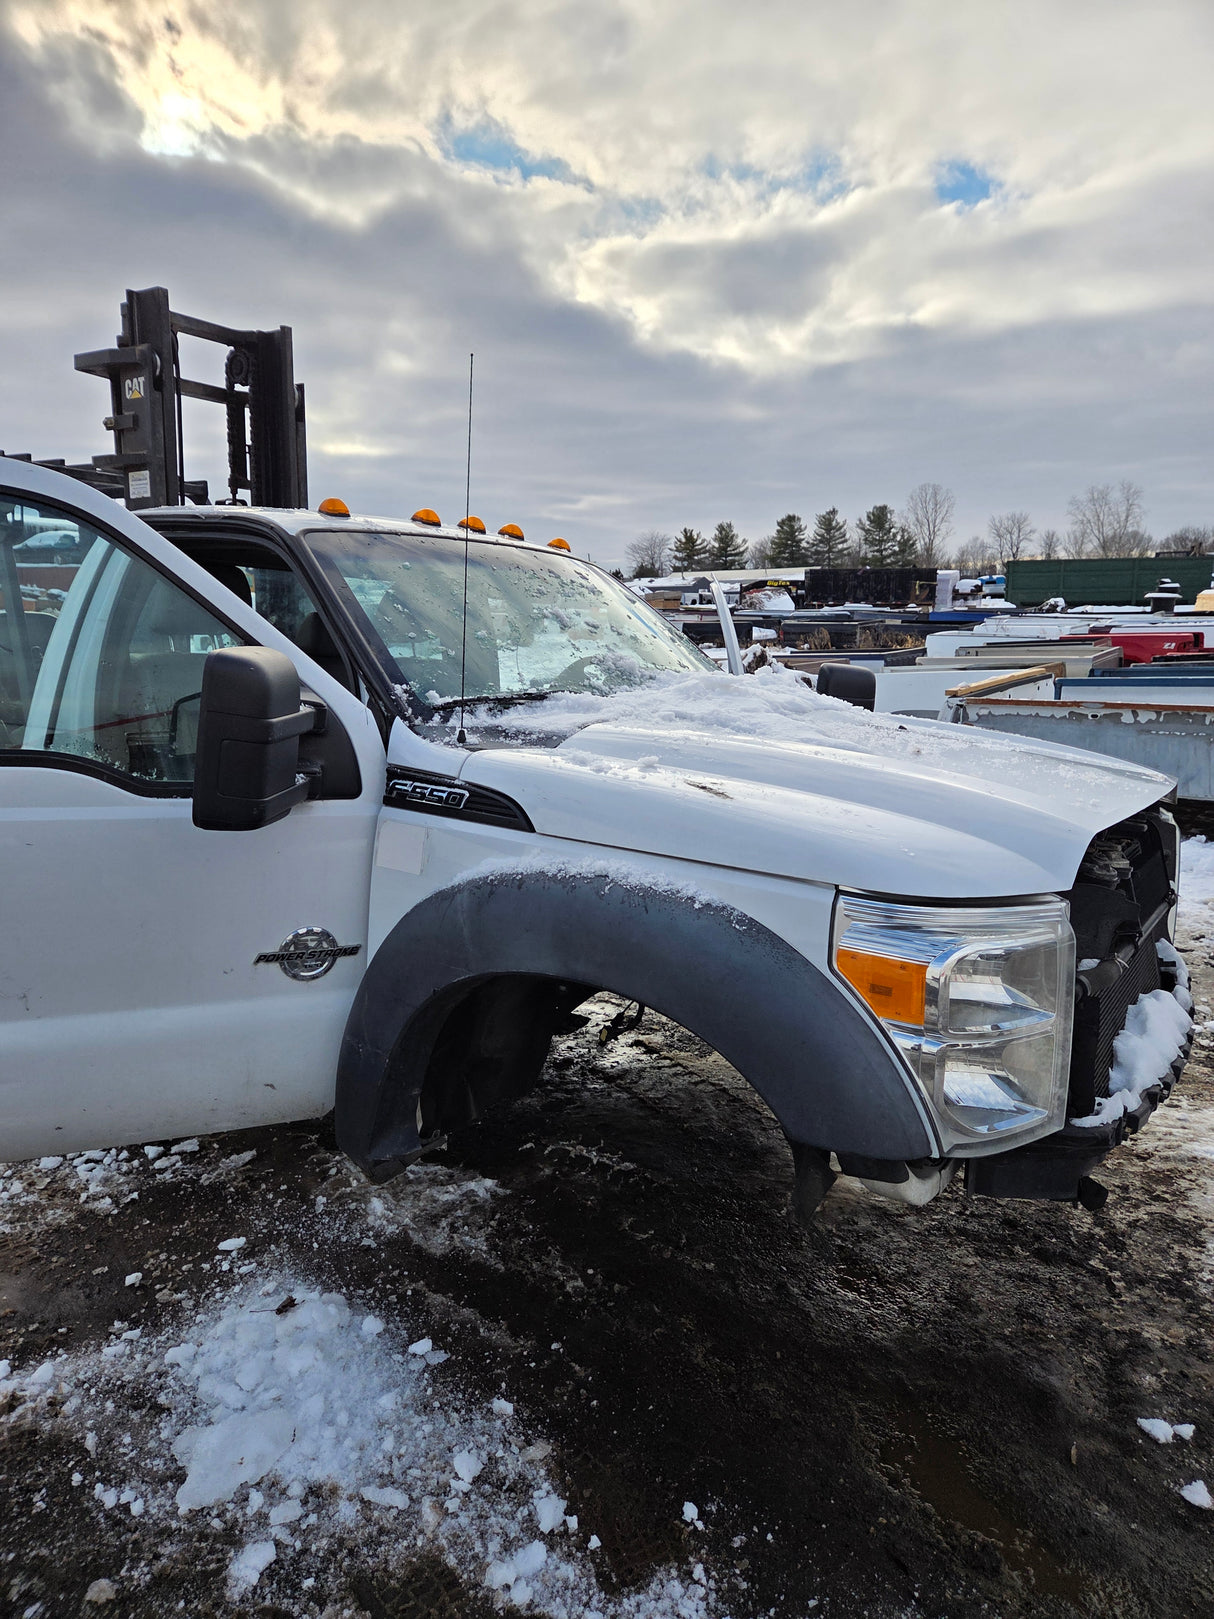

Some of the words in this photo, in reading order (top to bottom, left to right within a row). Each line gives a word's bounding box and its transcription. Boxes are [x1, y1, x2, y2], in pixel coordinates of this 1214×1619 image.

[125, 376, 145, 399] CAT
[388, 779, 470, 809] F550
[255, 951, 306, 963] POWER
[306, 946, 360, 959] STROKE
